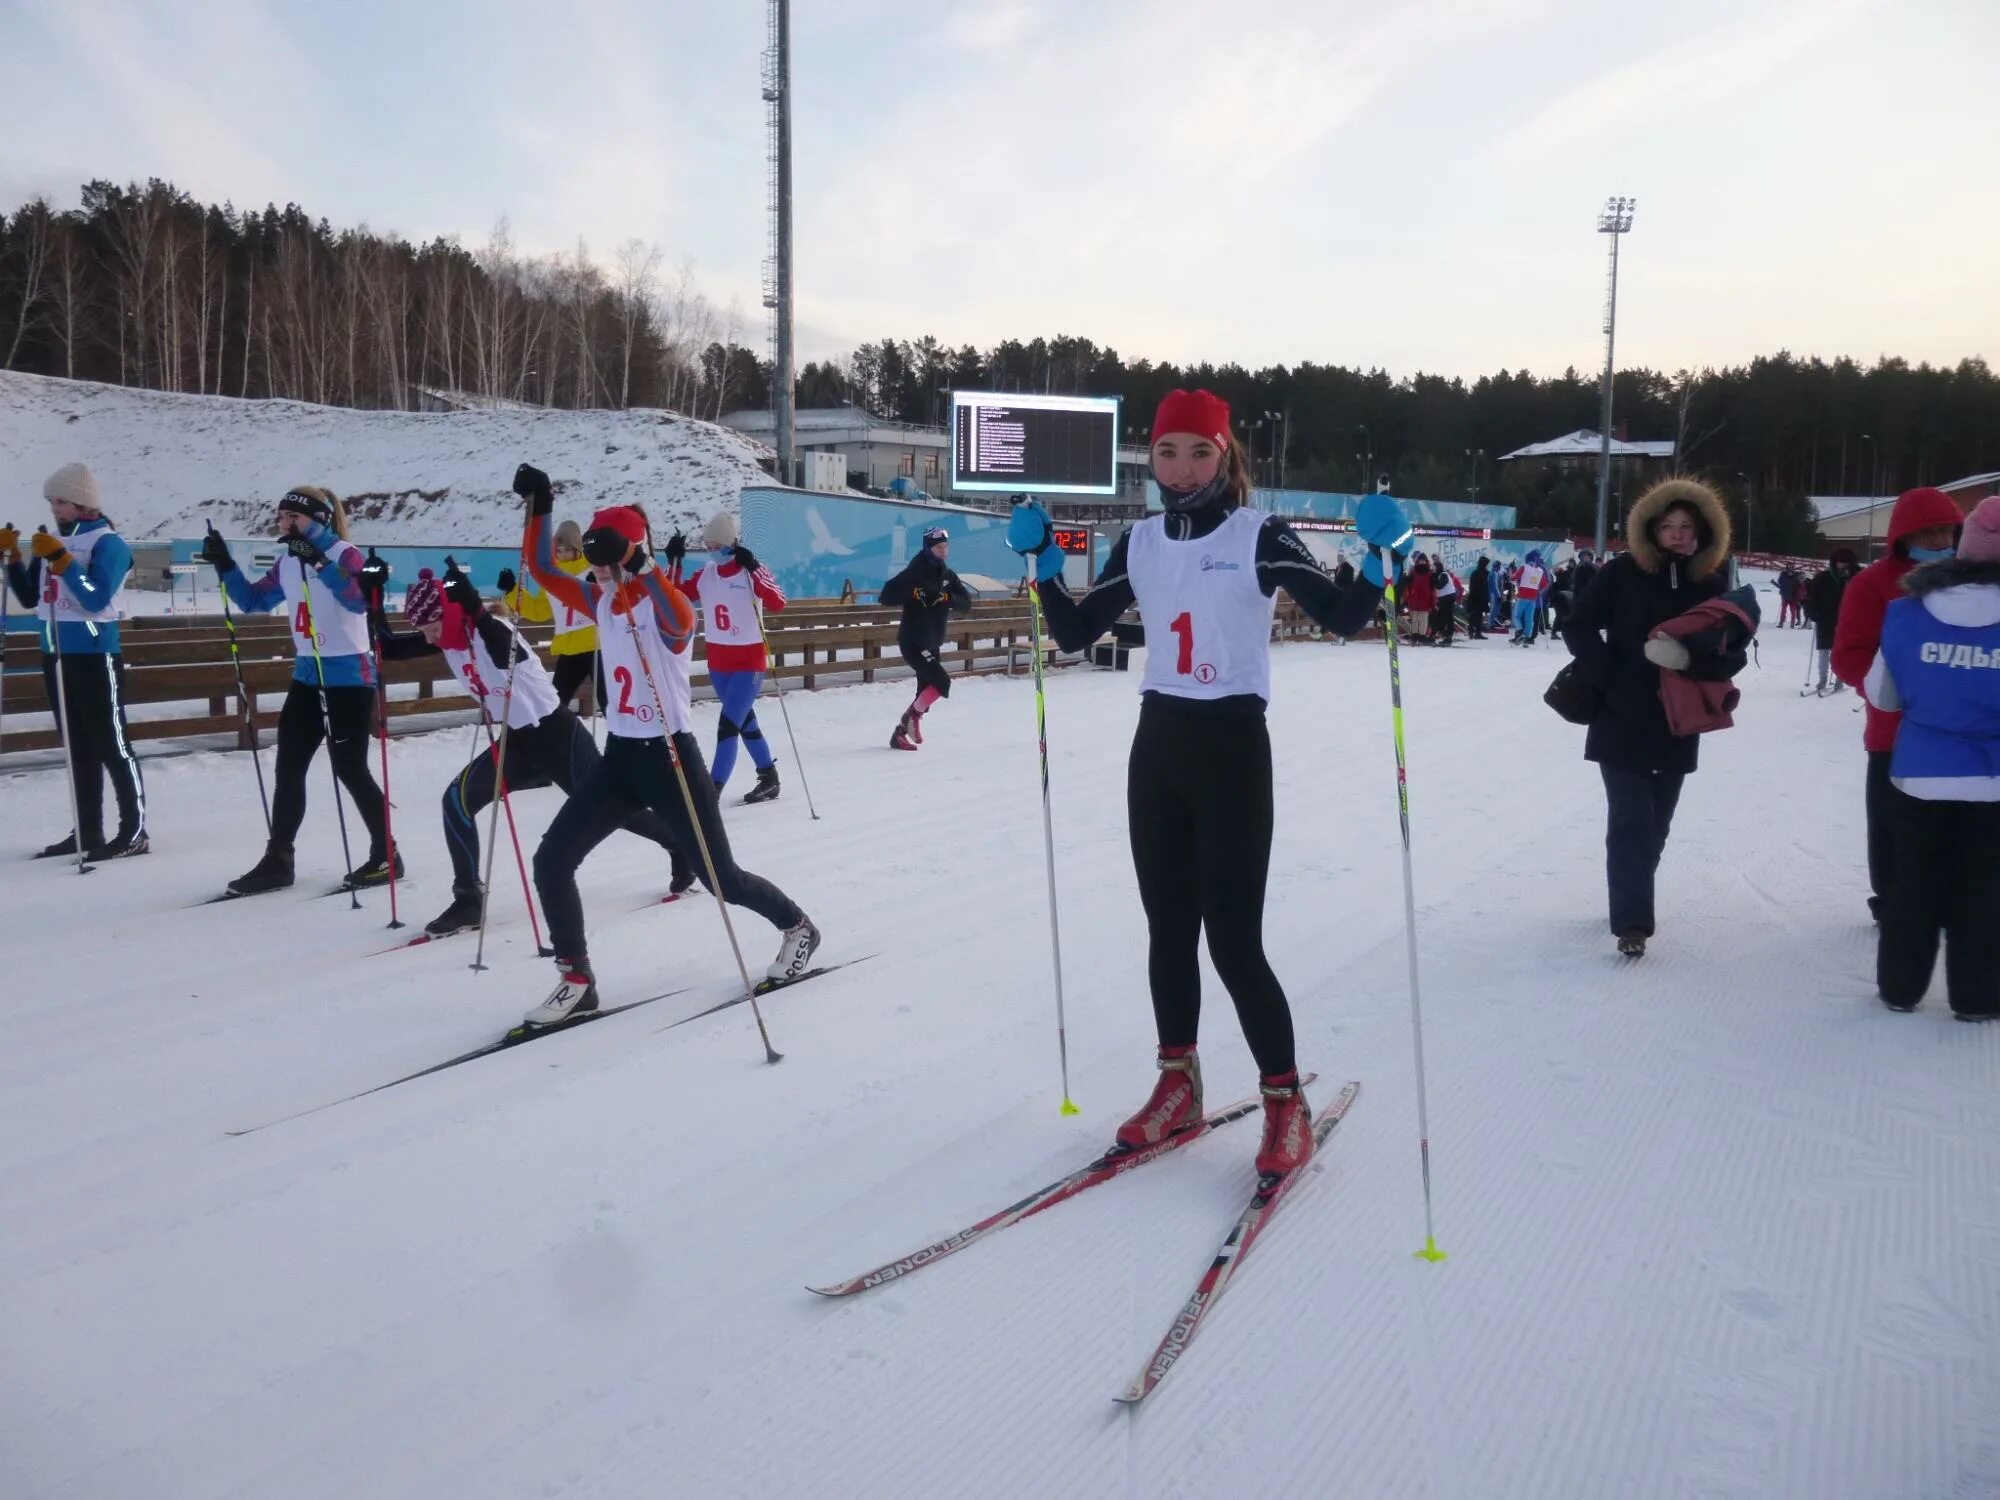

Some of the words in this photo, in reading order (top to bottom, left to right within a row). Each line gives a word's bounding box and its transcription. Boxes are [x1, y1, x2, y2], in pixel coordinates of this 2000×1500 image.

[295, 602, 315, 639] 4
[714, 604, 731, 631] 6
[1170, 612, 1193, 675] 1
[613, 666, 636, 716] 2
